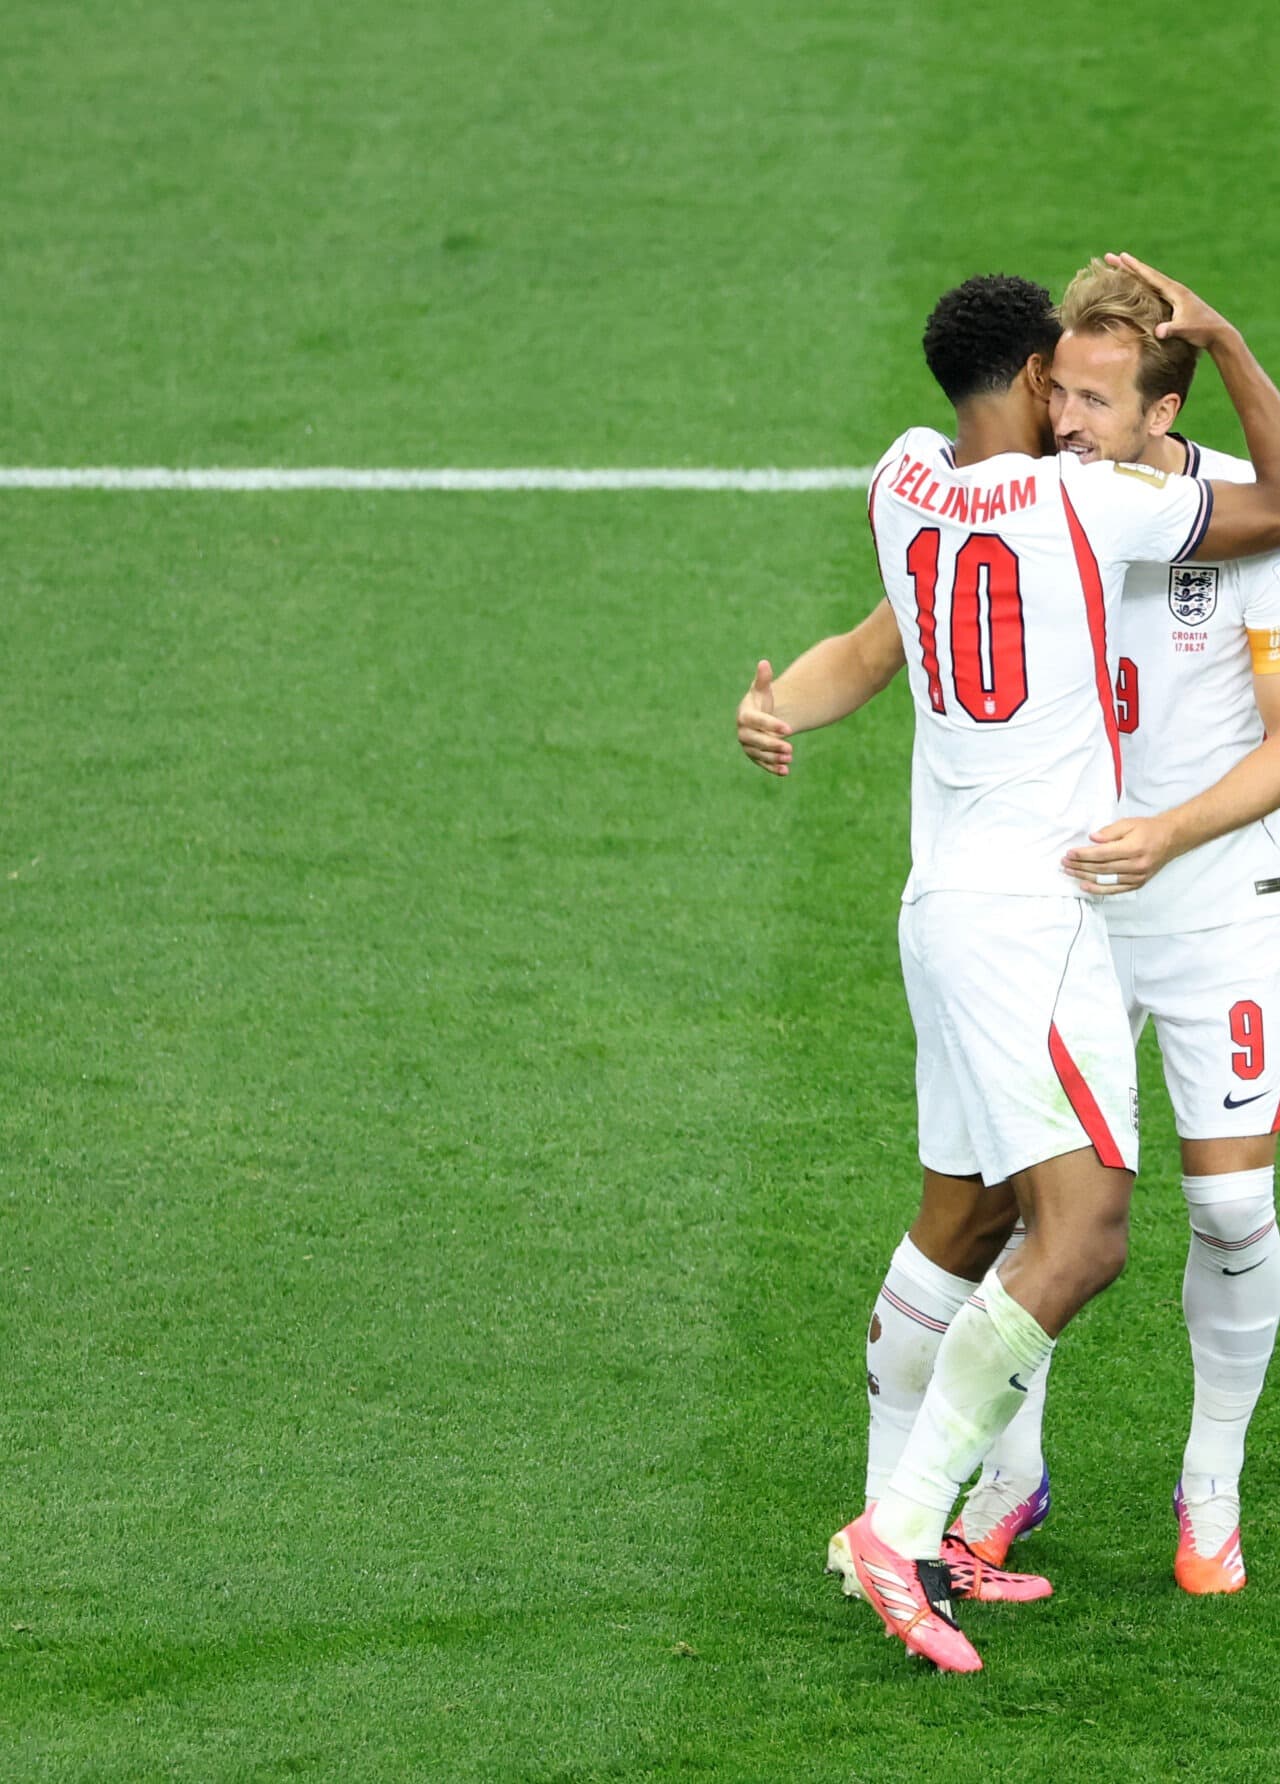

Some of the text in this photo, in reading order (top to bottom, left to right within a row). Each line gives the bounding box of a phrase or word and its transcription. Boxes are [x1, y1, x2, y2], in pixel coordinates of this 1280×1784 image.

[906, 527, 1028, 722] 10
[1172, 631, 1208, 641] CROATIA
[1116, 657, 1139, 734] 9
[1229, 999, 1265, 1080] 9
